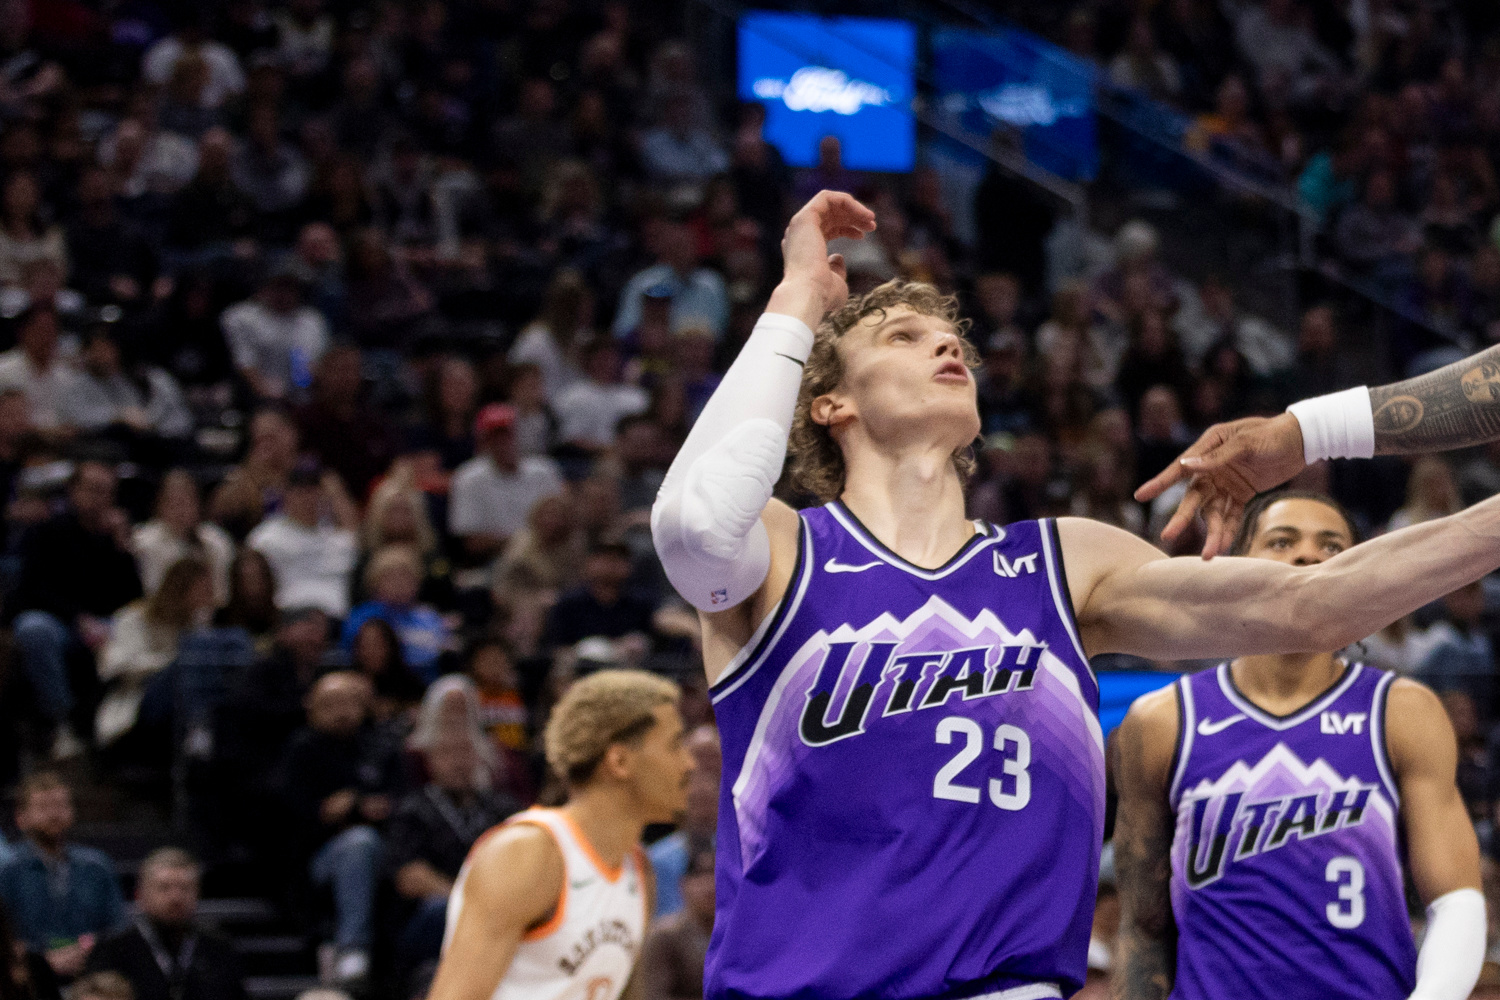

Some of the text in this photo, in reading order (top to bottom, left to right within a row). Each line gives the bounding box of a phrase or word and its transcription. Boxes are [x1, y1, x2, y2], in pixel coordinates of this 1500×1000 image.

[993, 549, 1039, 579] LVT
[799, 638, 1049, 748] UTAH
[1319, 711, 1367, 736] LVT
[932, 715, 1032, 812] 23
[1183, 783, 1380, 892] UTAH
[1325, 855, 1366, 930] 3
